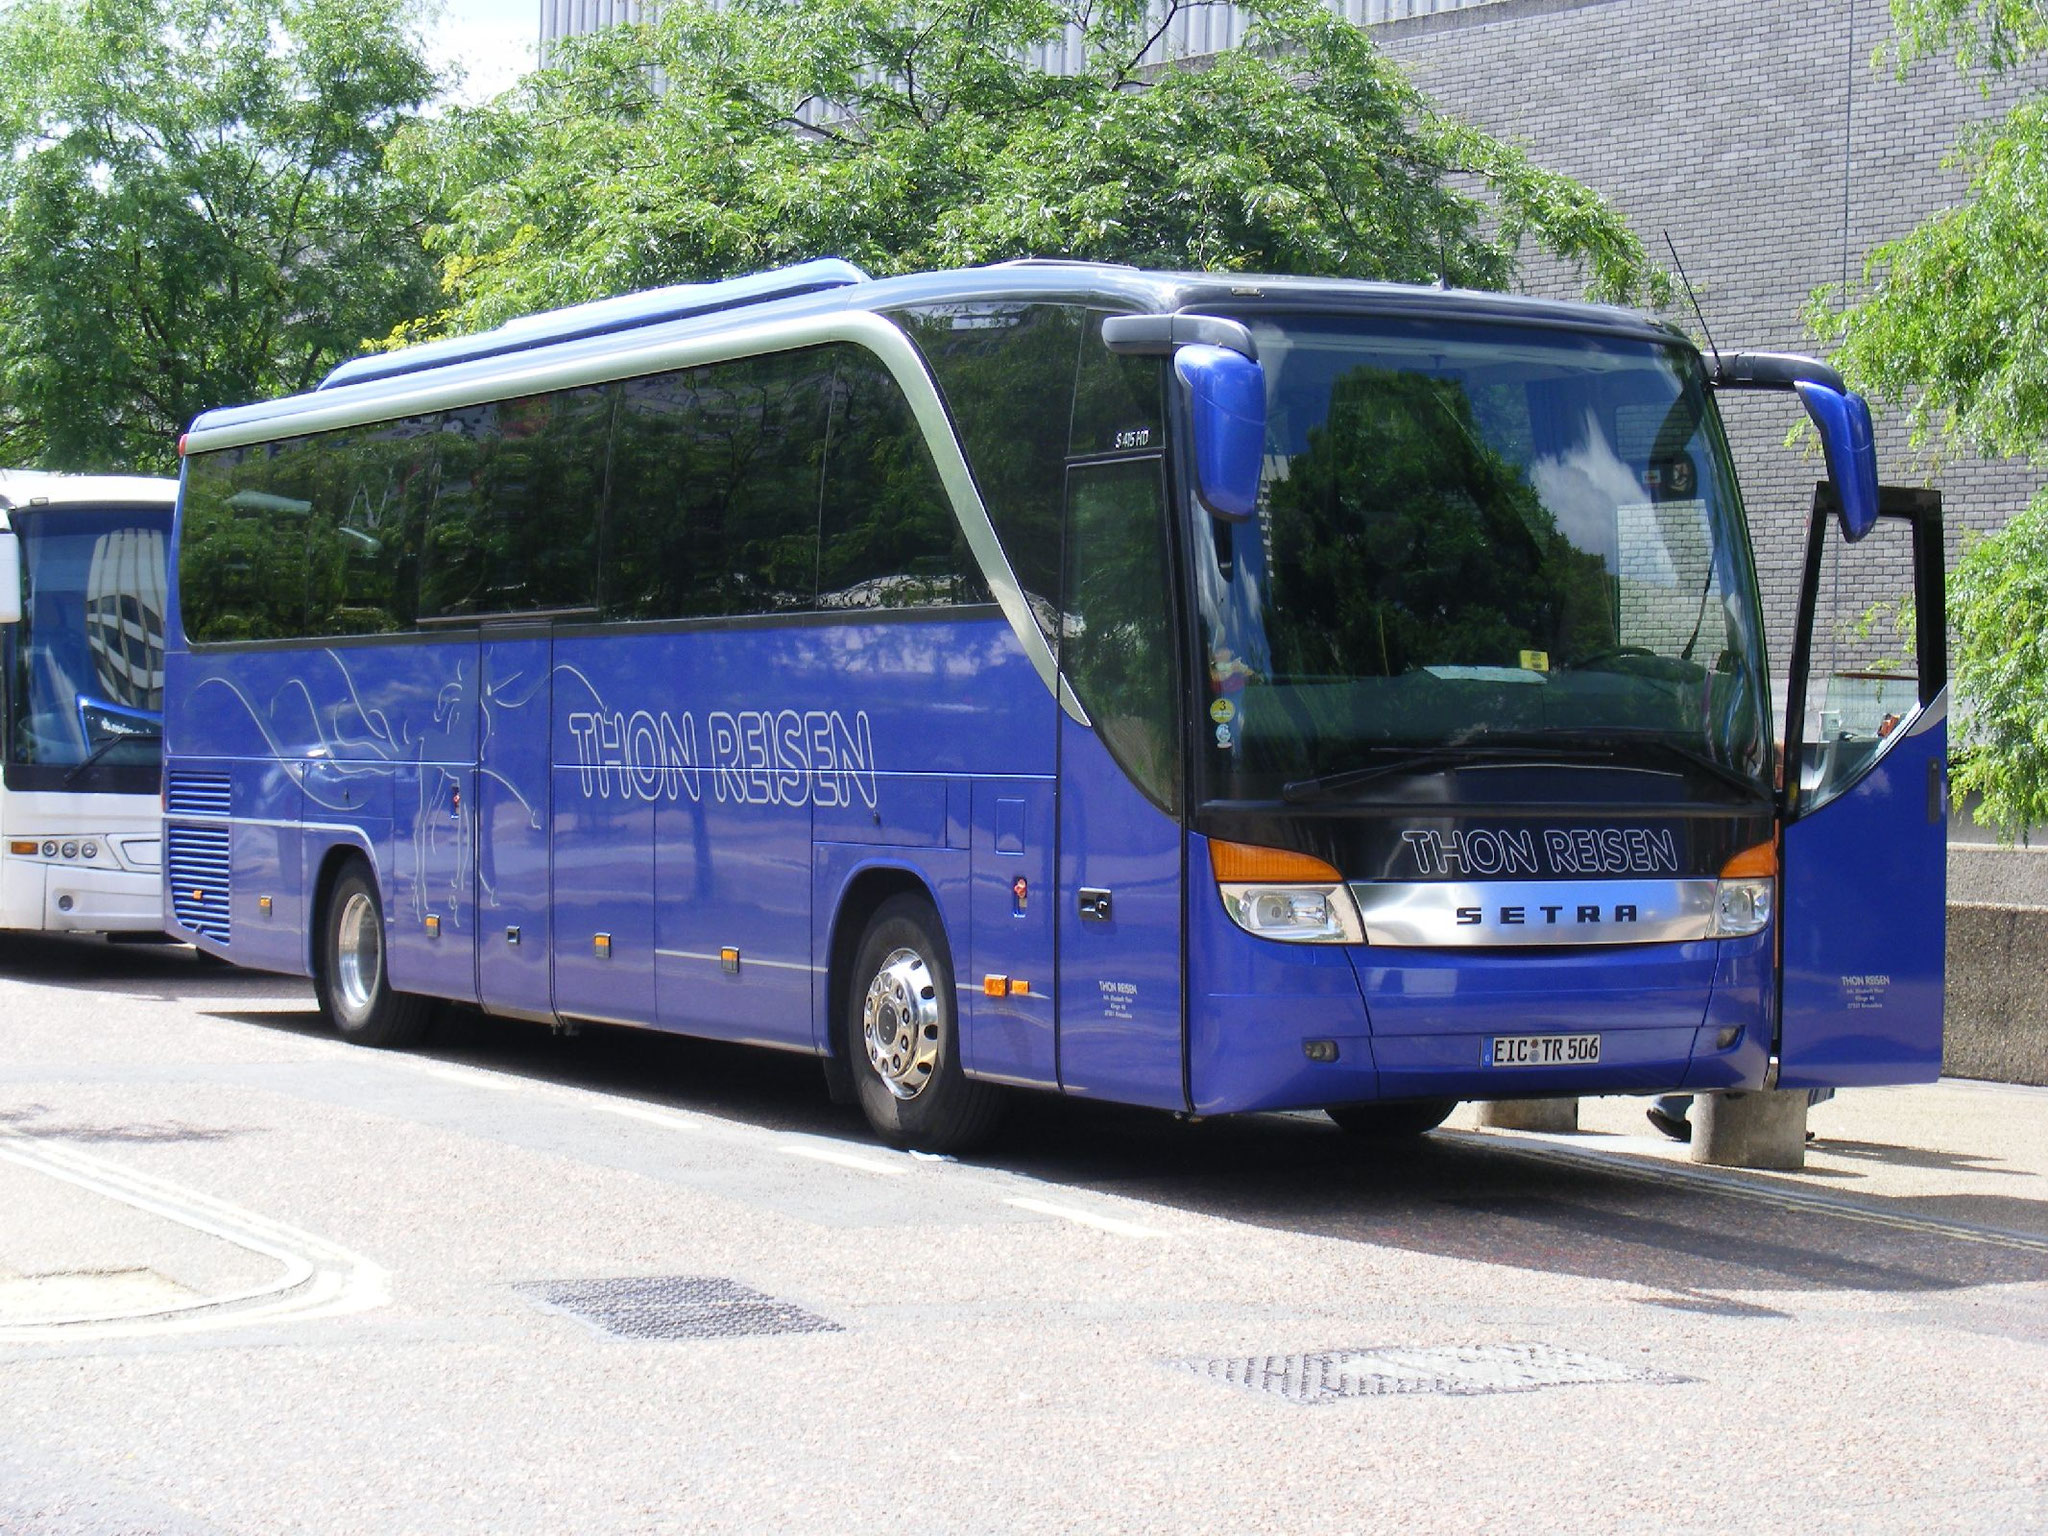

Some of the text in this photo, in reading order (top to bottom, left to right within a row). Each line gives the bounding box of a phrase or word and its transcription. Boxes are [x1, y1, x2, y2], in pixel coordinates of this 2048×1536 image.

[1115, 432, 1122, 448] S
[1136, 429, 1149, 446] HD
[568, 708, 878, 808] THON REISEN
[1401, 829, 1679, 874] THON REISEN
[1456, 904, 1638, 926] SETRA
[1099, 980, 1138, 995] THON REISEN
[1841, 974, 1890, 986] THON REISEN
[1494, 1037, 1599, 1062] EIC TR 506
